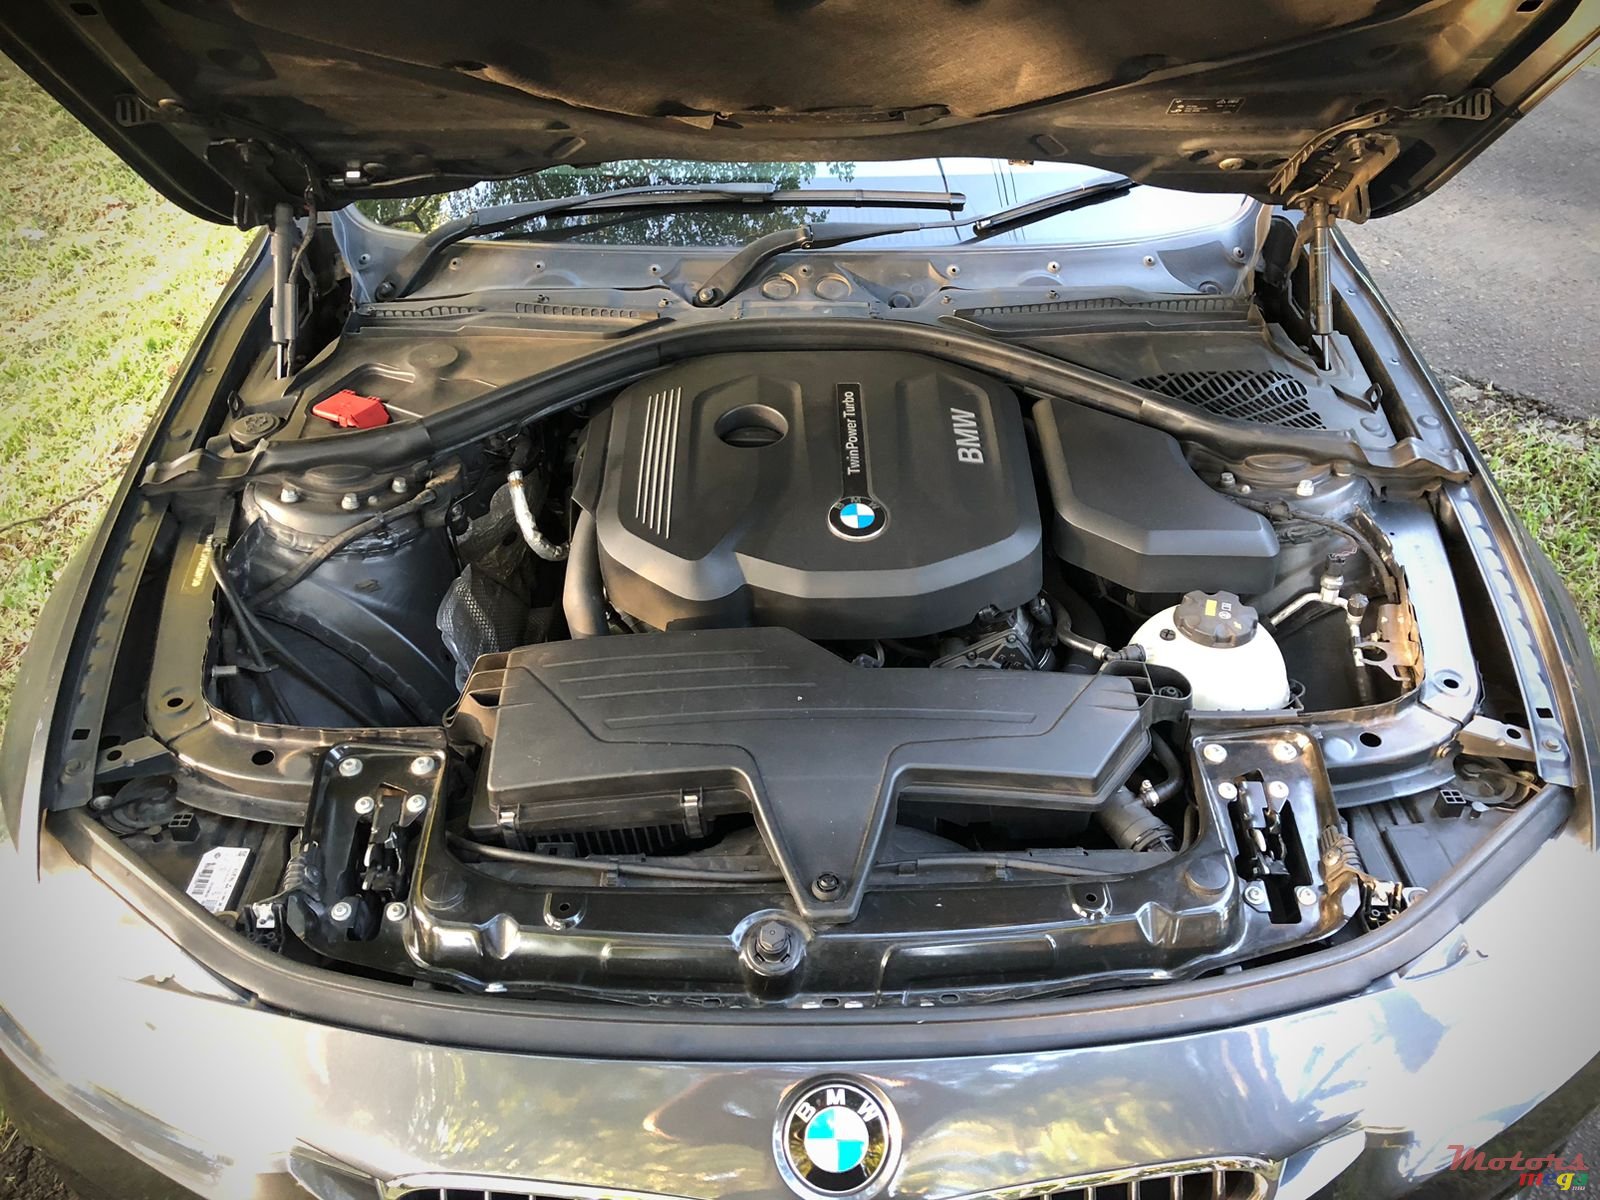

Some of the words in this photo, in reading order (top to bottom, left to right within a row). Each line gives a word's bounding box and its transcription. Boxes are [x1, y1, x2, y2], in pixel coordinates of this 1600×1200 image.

[842, 391, 855, 418] Turbo
[845, 418, 861, 475] TwinPower
[950, 408, 984, 464] BMW
[795, 1088, 880, 1123] BMW
